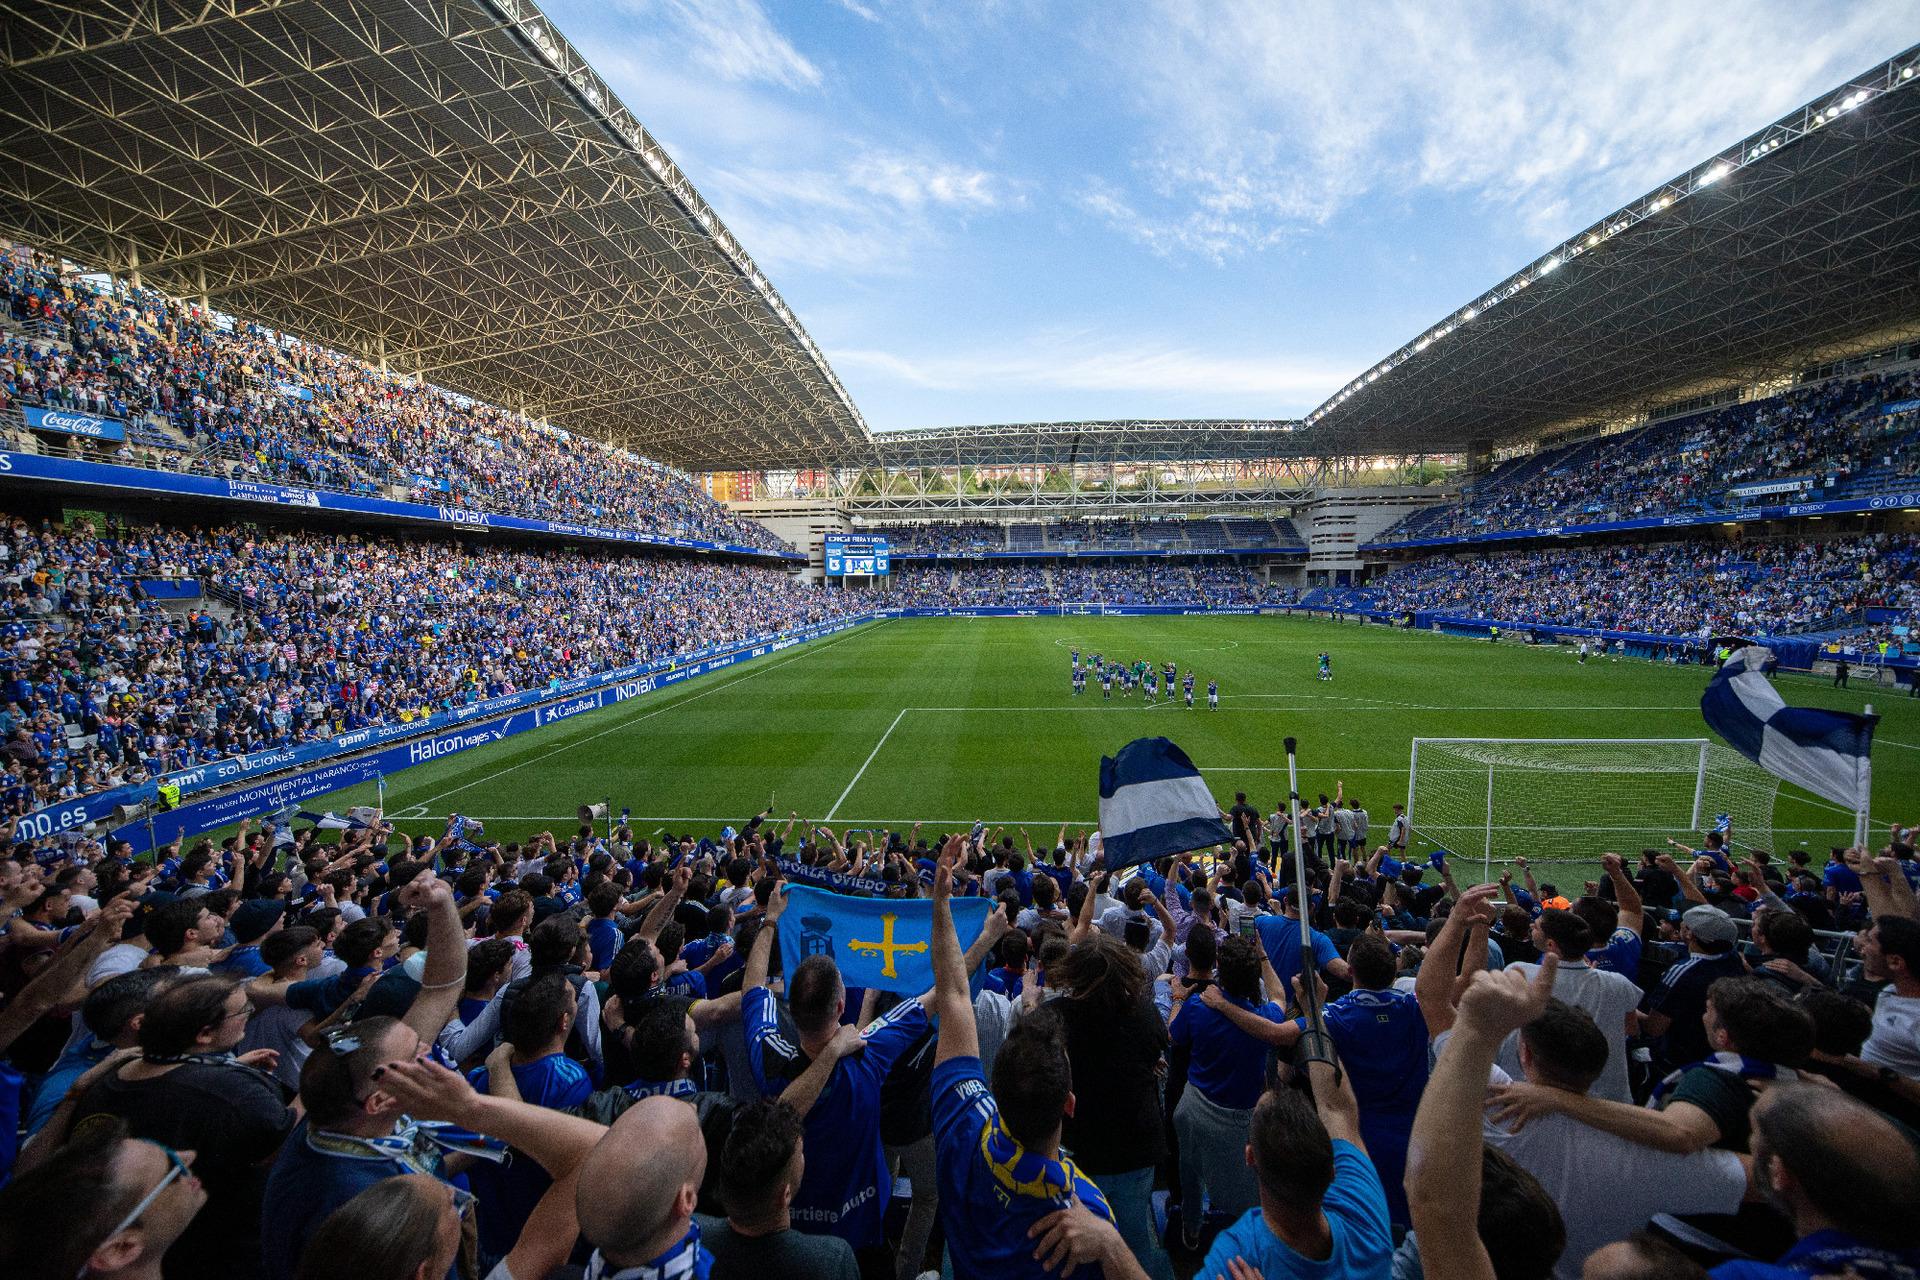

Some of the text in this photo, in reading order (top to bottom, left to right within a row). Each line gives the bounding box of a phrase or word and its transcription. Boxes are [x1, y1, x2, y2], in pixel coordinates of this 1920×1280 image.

[440, 504, 489, 525] INDIBA
[616, 677, 657, 702] INDIBA
[558, 697, 596, 718] CaixaBank
[378, 718, 430, 738] SOLUCIONES
[410, 732, 490, 763] Halcon viajes
[240, 776, 312, 804] MONUMENTAL
[315, 762, 360, 781] NARANCO
[832, 872, 887, 892] OVIEDO
[790, 1206, 838, 1223] artiere
